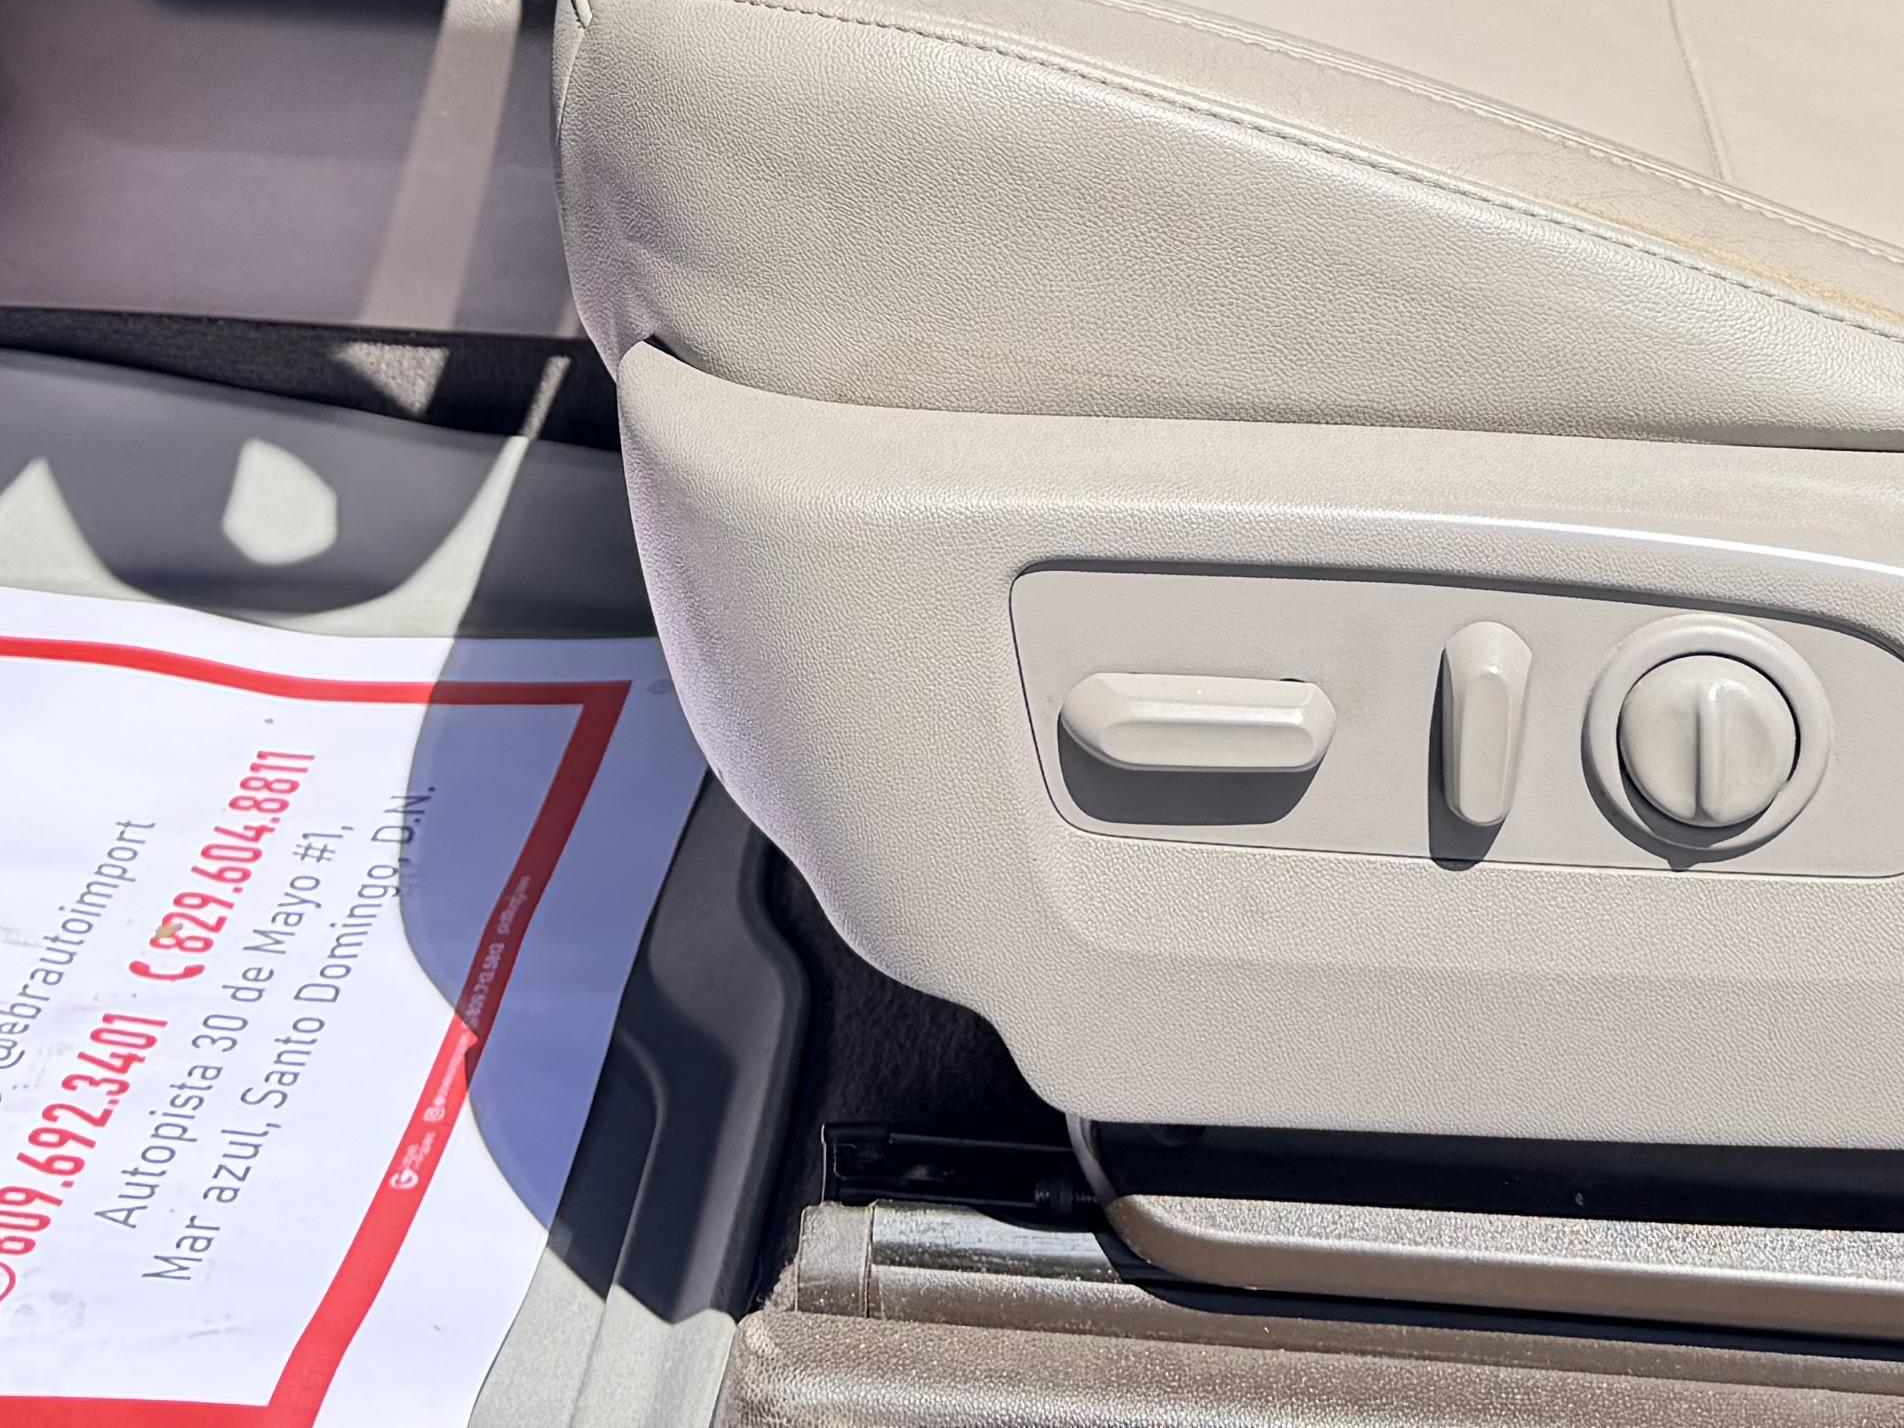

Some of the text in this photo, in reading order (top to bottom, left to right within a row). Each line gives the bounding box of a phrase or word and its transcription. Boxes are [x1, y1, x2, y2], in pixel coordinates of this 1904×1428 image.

[93, 826, 354, 1229] Autopista 30 de Mayo #1,
[141, 786, 436, 1281] Mar azul, Santo Domingo, D.N.
[149, 750, 315, 953] 829.604.8811
